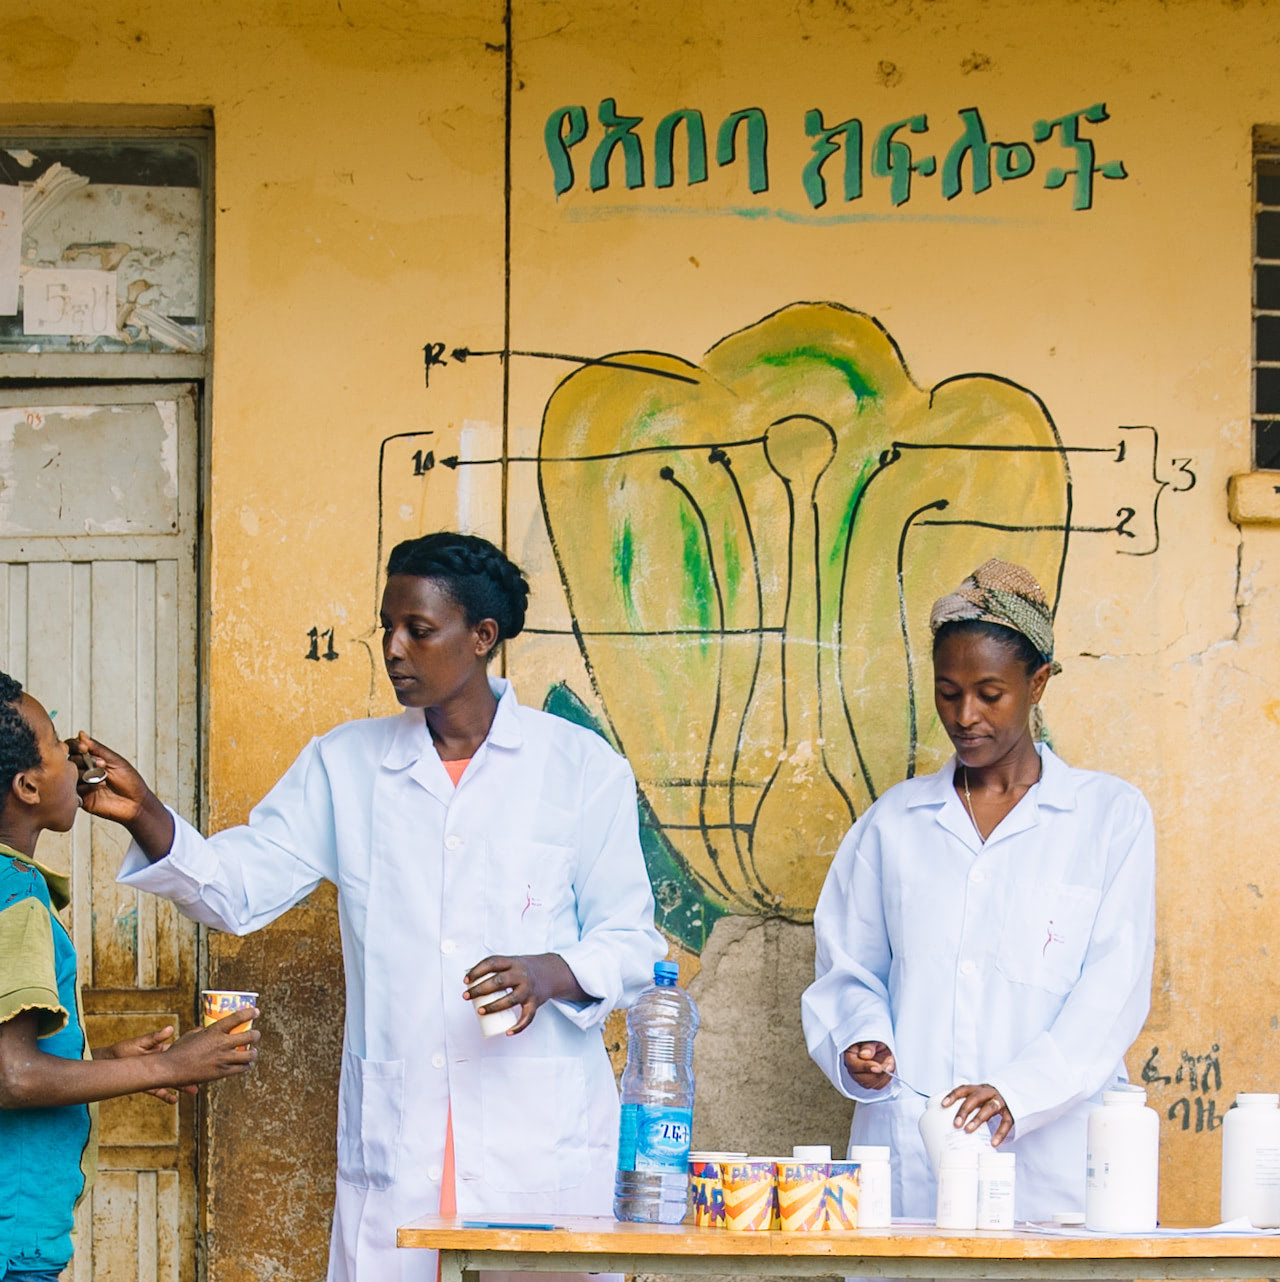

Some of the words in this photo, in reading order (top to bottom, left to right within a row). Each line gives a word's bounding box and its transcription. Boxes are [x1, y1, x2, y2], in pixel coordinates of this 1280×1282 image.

[544, 98, 769, 196] የአበባ
[802, 102, 1127, 211] ክፍሎች
[1113, 440, 1126, 462] 1
[1172, 457, 1197, 492] 3
[1116, 507, 1136, 539] 2
[305, 625, 340, 662] 11
[1168, 1096, 1239, 1134] ባዜ
